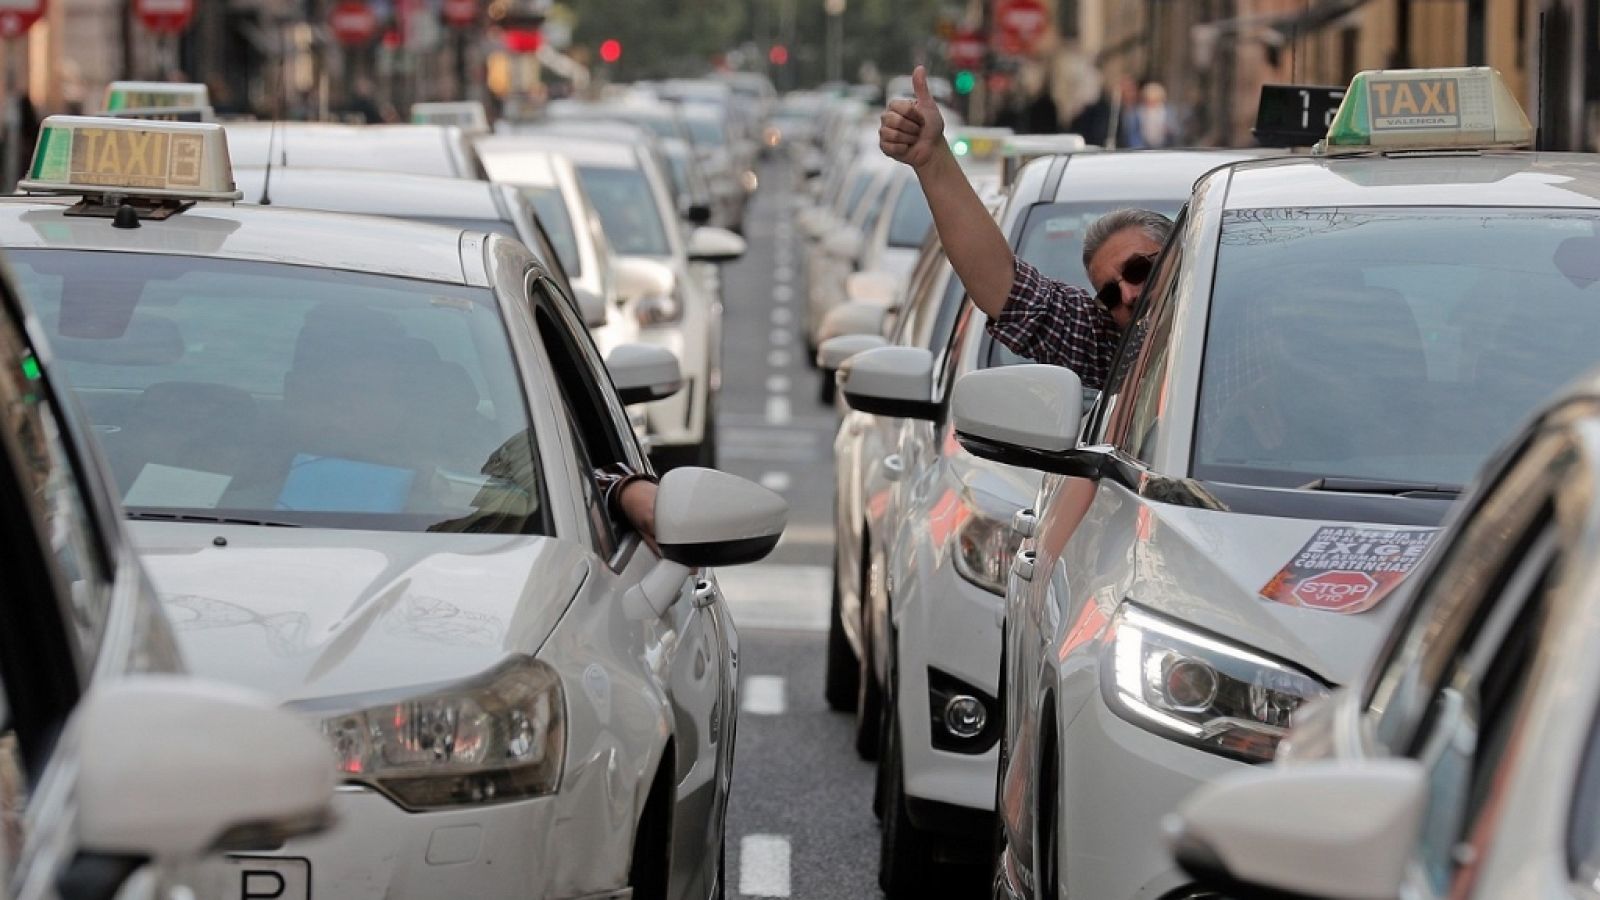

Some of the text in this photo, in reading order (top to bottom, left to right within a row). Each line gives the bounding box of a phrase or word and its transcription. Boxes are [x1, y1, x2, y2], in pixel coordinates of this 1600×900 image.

[1372, 82, 1456, 114] TAXI
[1386, 118, 1446, 126] VALENCIA
[81, 128, 163, 177] TAXI
[1308, 541, 1426, 557] EXIGE
[1295, 559, 1413, 573] COMPETENCIAS
[1301, 582, 1369, 597] STOP
